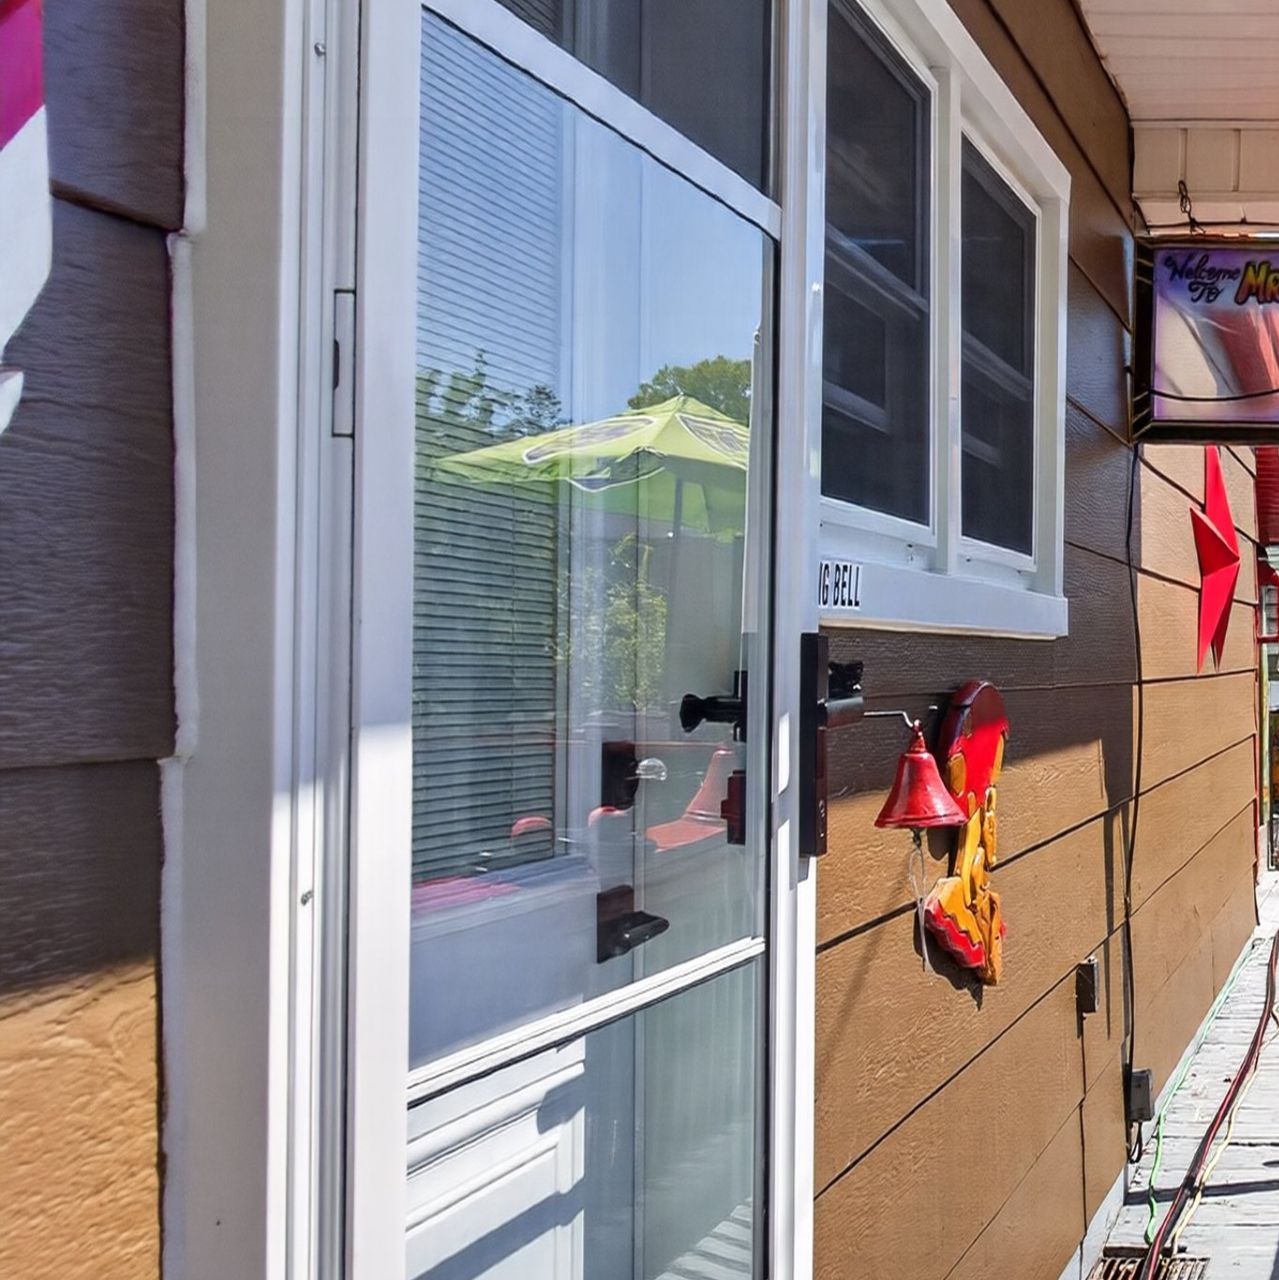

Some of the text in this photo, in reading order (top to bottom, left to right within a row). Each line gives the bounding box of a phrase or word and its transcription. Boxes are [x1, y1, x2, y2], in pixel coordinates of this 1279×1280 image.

[1164, 254, 1240, 282] Welcome
[818, 561, 860, 607] G BELL
